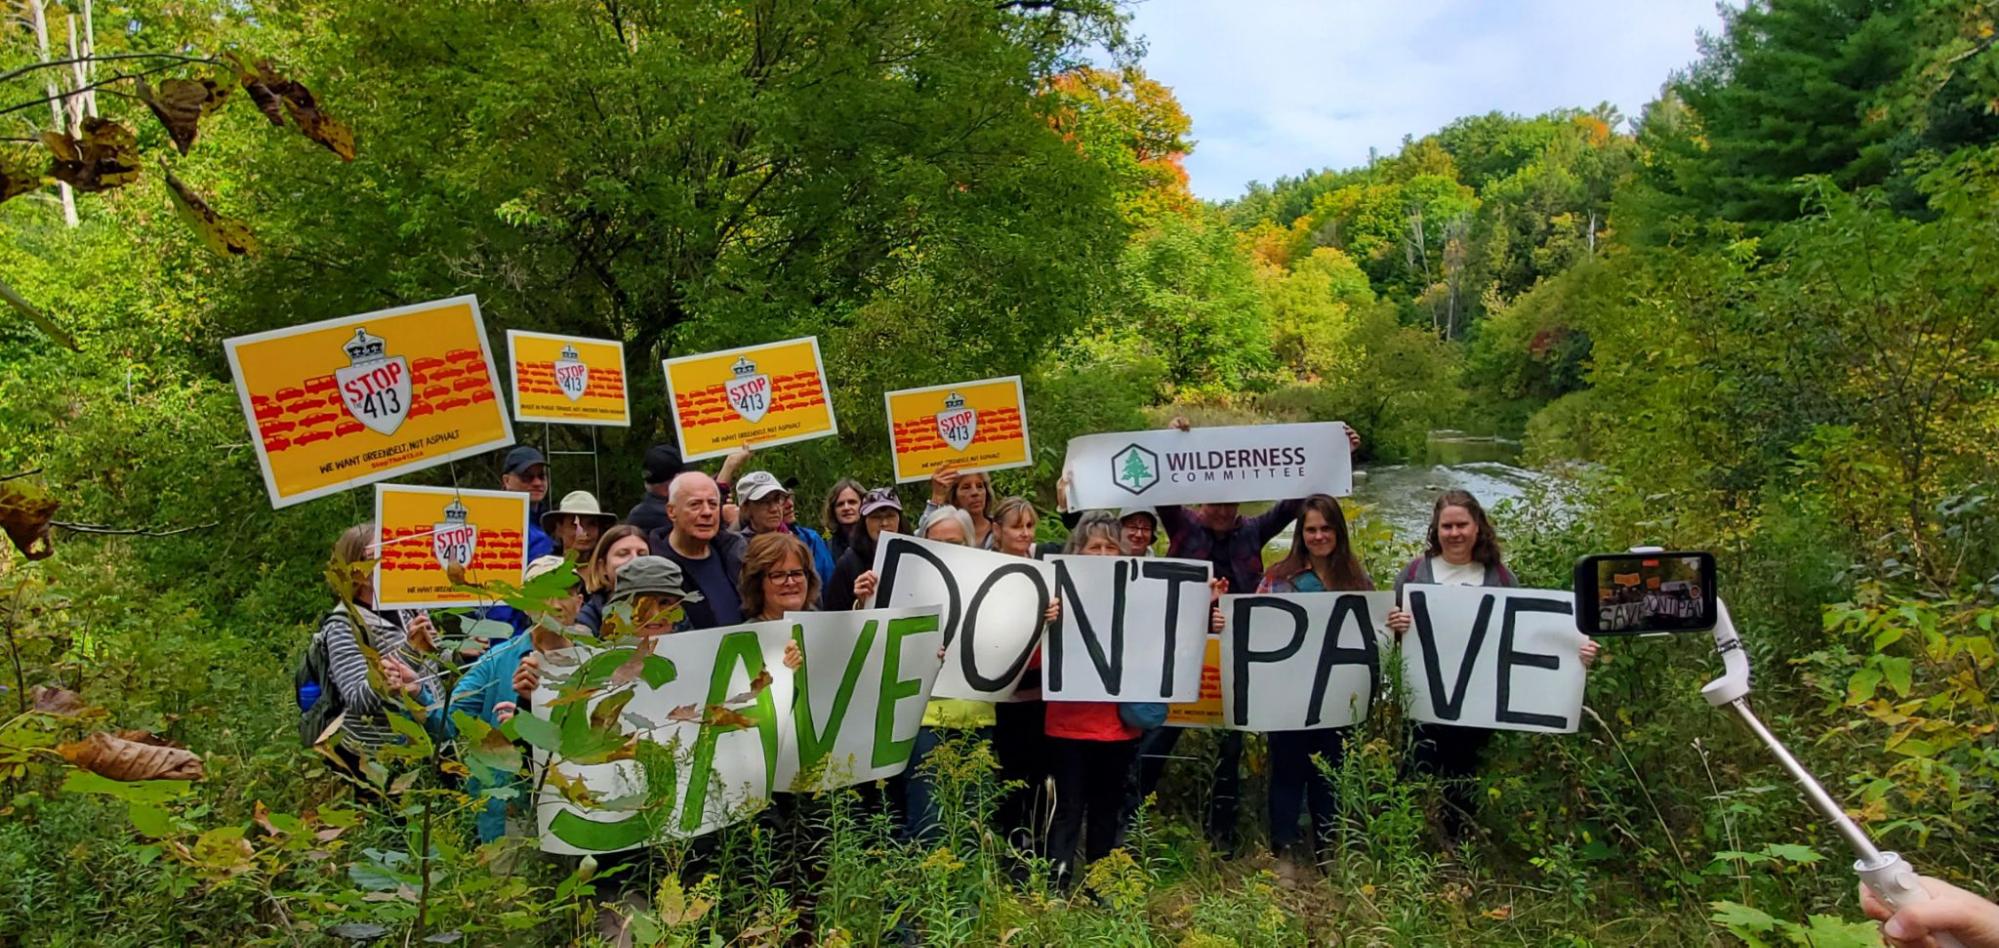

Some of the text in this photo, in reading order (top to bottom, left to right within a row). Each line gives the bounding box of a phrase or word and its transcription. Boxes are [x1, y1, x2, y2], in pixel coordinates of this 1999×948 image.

[344, 362, 402, 404] STOP
[558, 365, 585, 379] STOP
[564, 377, 582, 391] 413
[730, 377, 766, 400] STOP
[363, 387, 401, 419] 413
[740, 393, 764, 412] 413
[940, 411, 972, 432] STOP
[948, 425, 969, 441] 413
[319, 464, 334, 474] WE
[336, 456, 361, 469] WANT
[409, 439, 424, 451] NOT
[426, 429, 460, 446] ASPHALT
[1166, 447, 1306, 472] WILDERNESS
[1171, 466, 1306, 483] COMMITTEE
[437, 528, 473, 550] STOP
[443, 545, 466, 564] 413
[873, 538, 1574, 729] DON'T PAVE
[548, 613, 940, 852] SAVE
